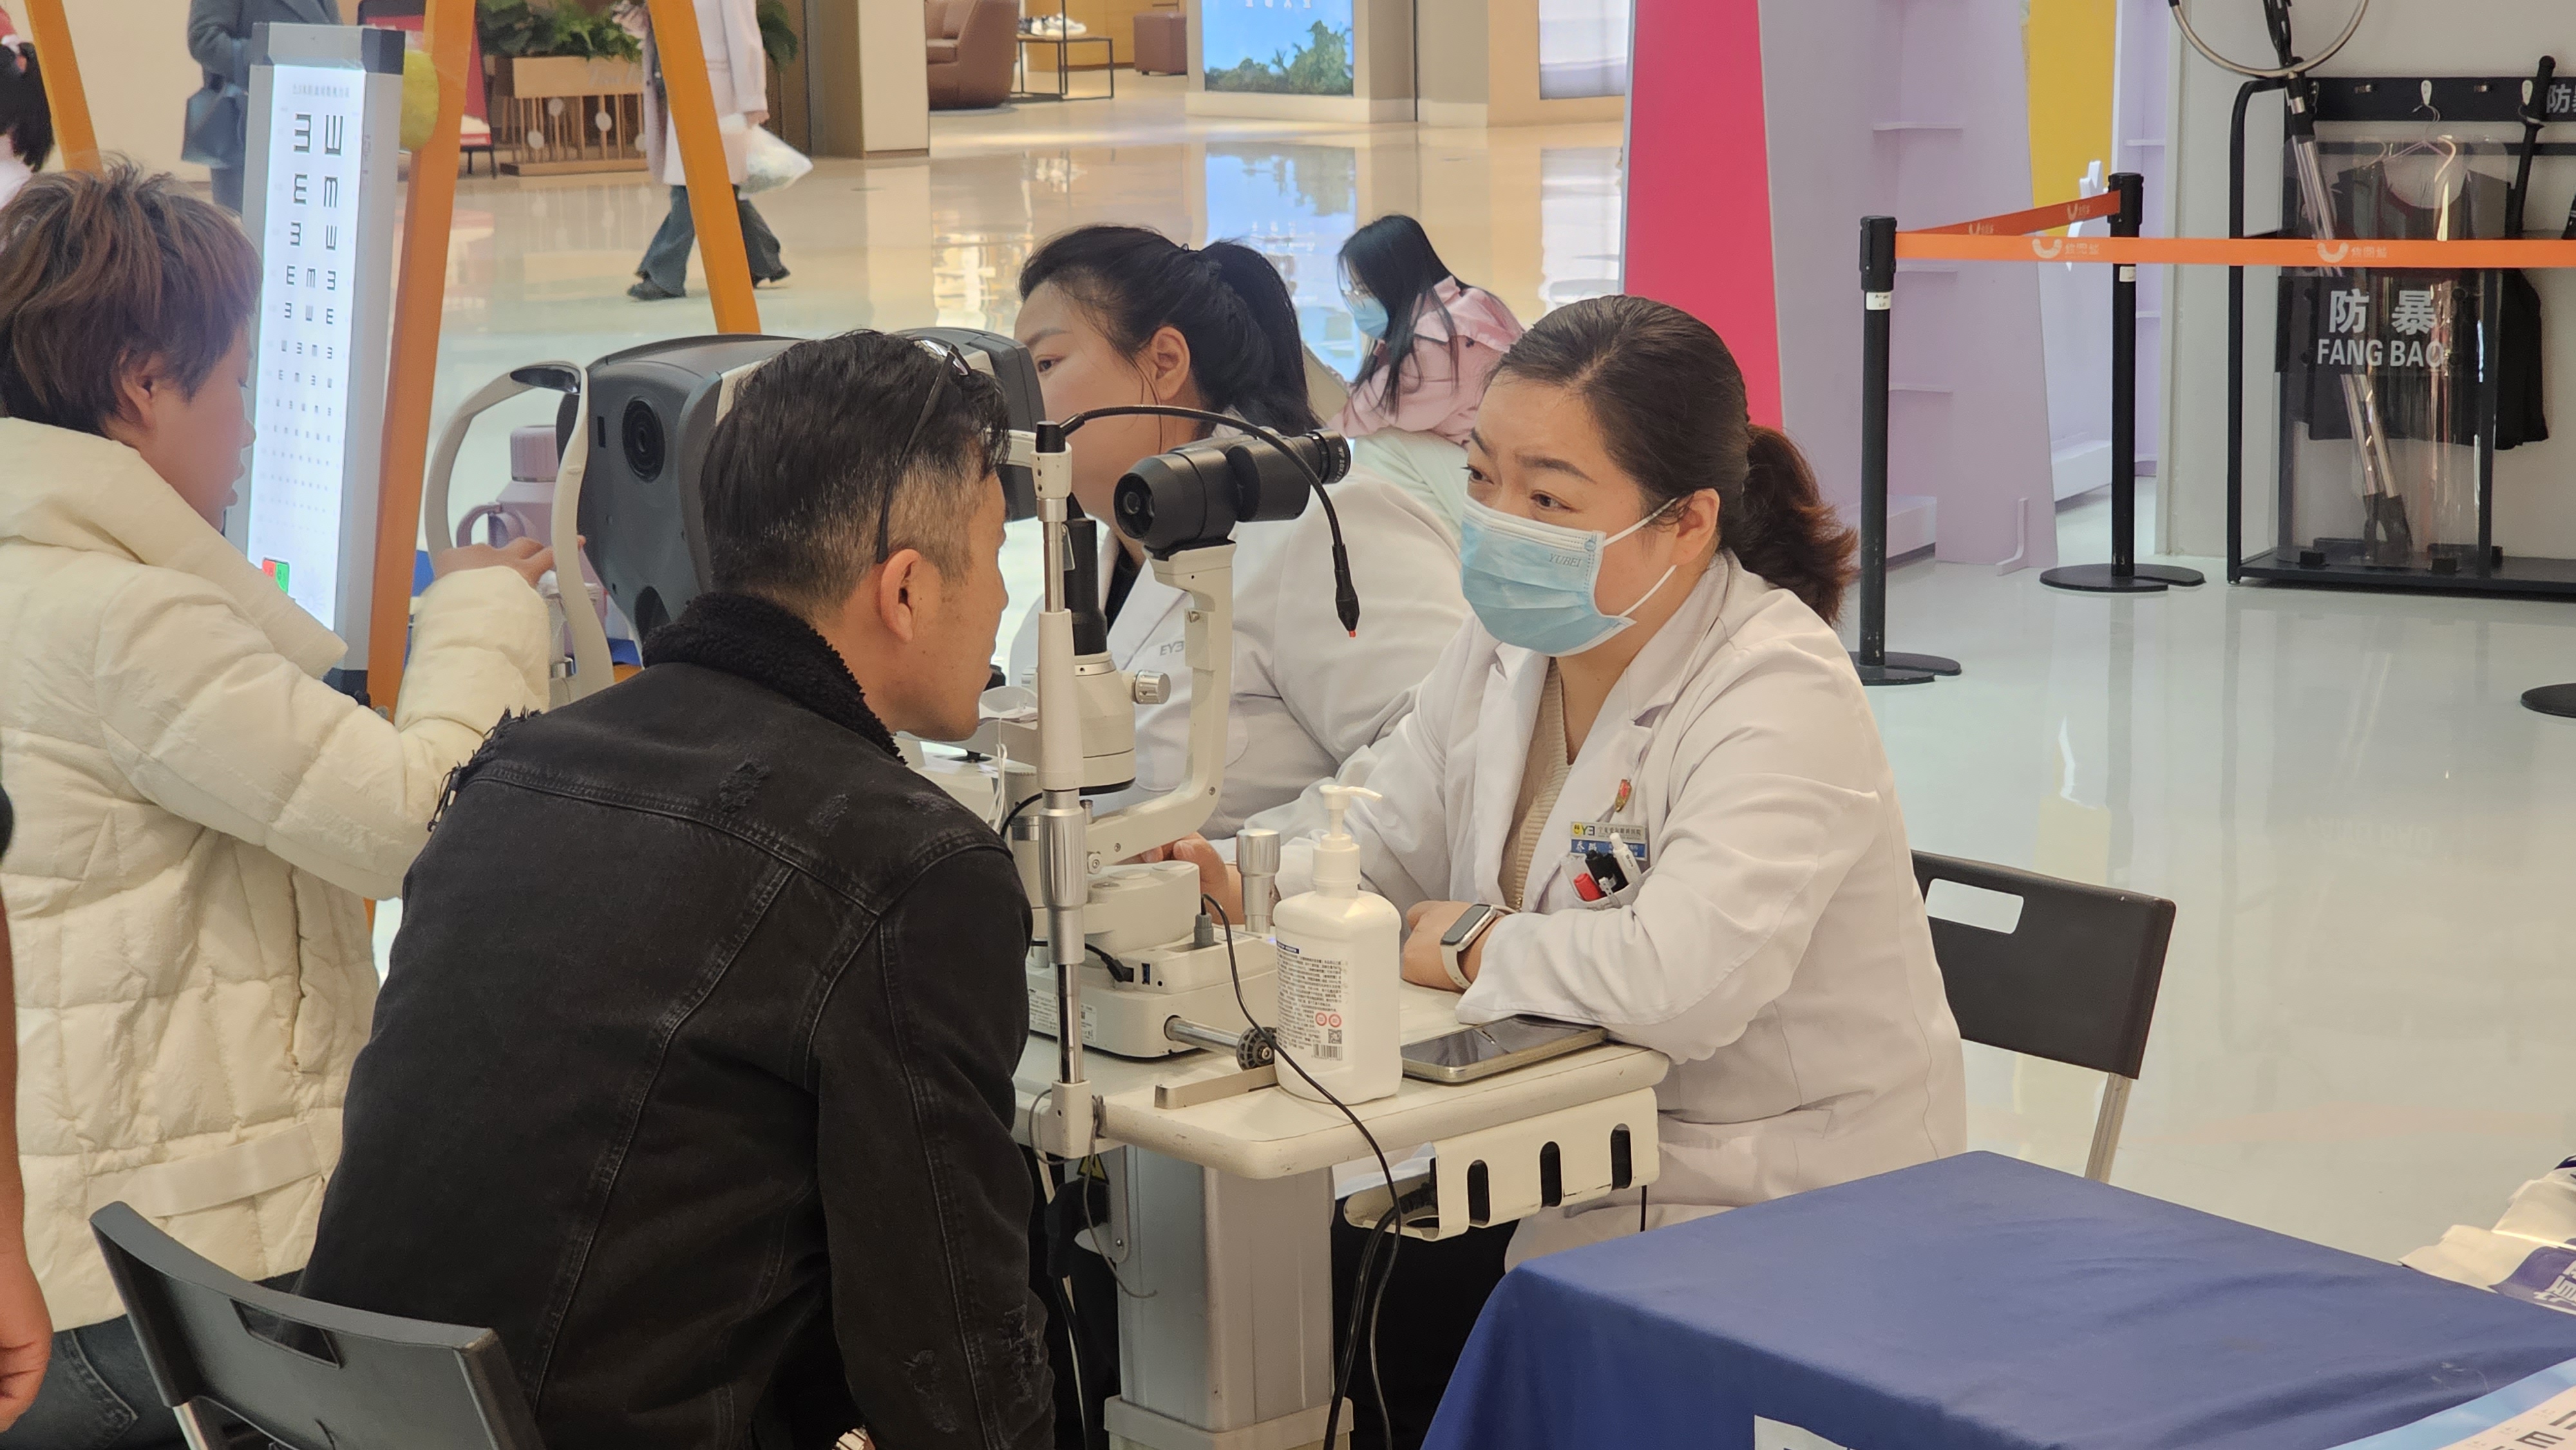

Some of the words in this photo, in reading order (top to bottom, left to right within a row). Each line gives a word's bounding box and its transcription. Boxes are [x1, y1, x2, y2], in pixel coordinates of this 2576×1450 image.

[2546, 84, 2576, 113] 防
[2329, 288, 2438, 335] 防暴
[2318, 338, 2383, 366] FANG
[2390, 339, 2444, 368] BAO
[1549, 554, 1582, 567] YUBEI
